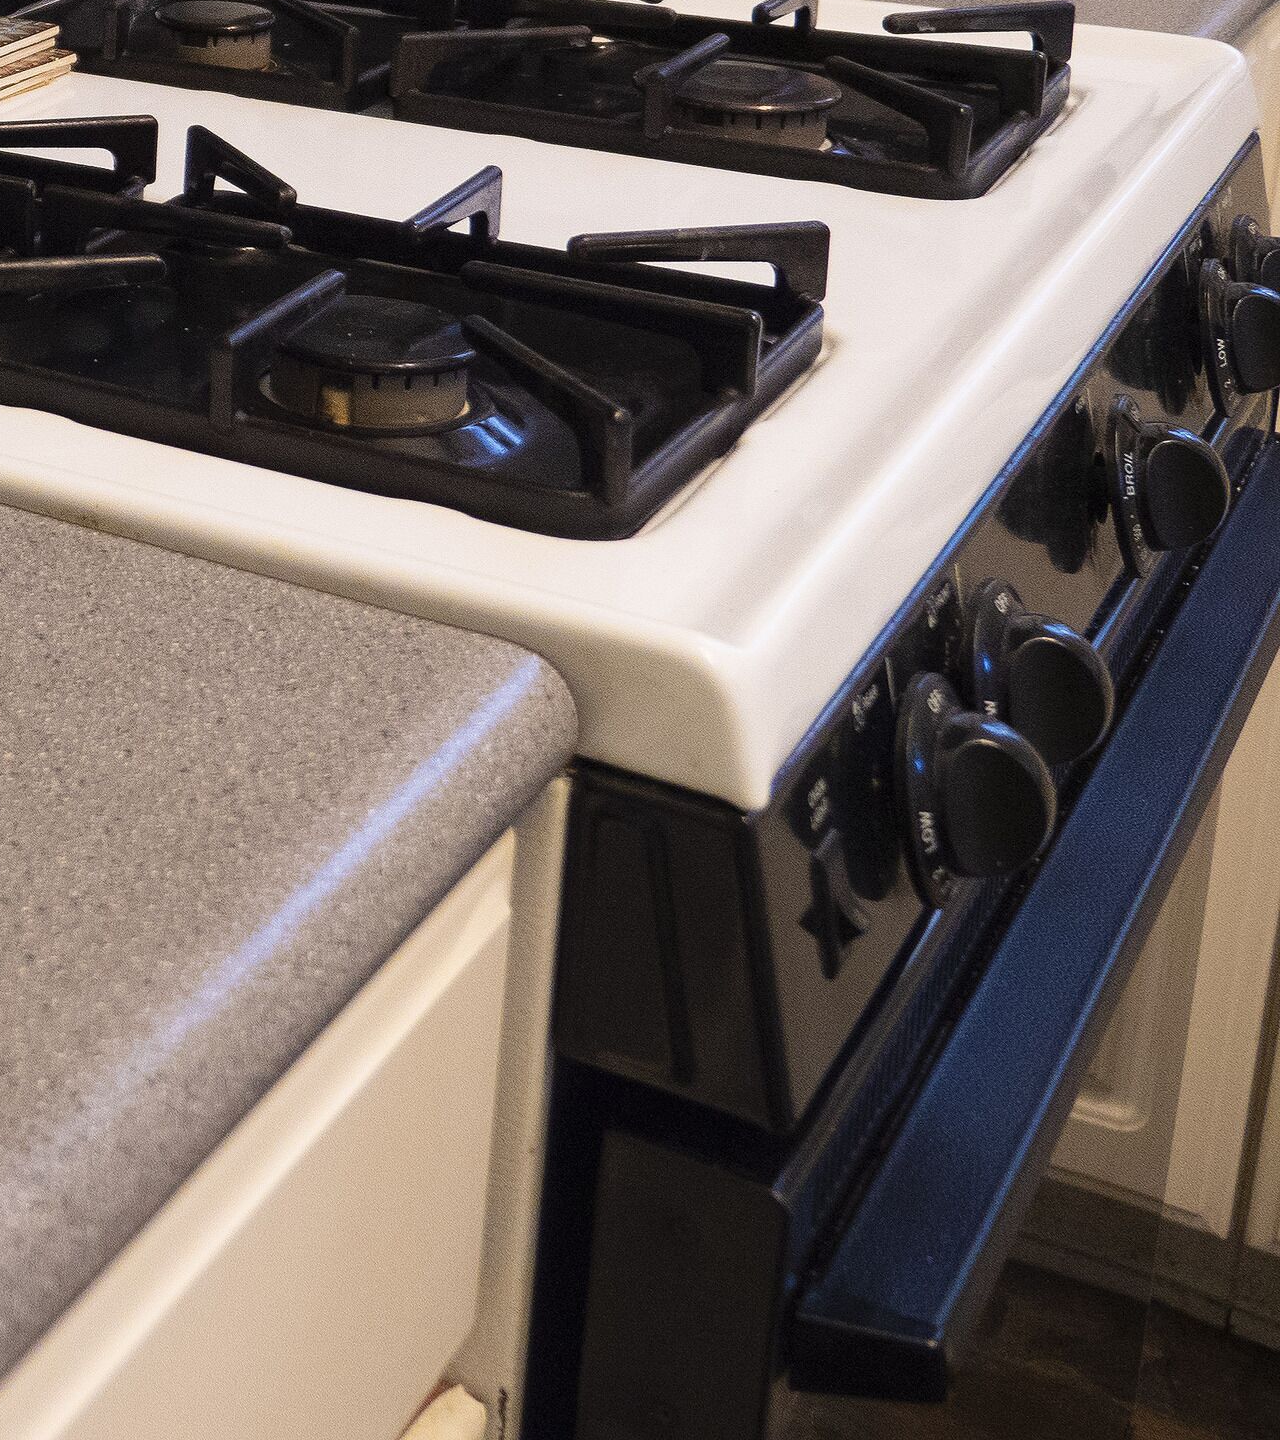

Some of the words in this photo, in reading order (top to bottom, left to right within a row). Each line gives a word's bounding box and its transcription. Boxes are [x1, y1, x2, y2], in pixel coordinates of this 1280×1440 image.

[1215, 337, 1228, 369] LOW
[1123, 451, 1137, 497] BROIL
[918, 810, 938, 854] LOW
